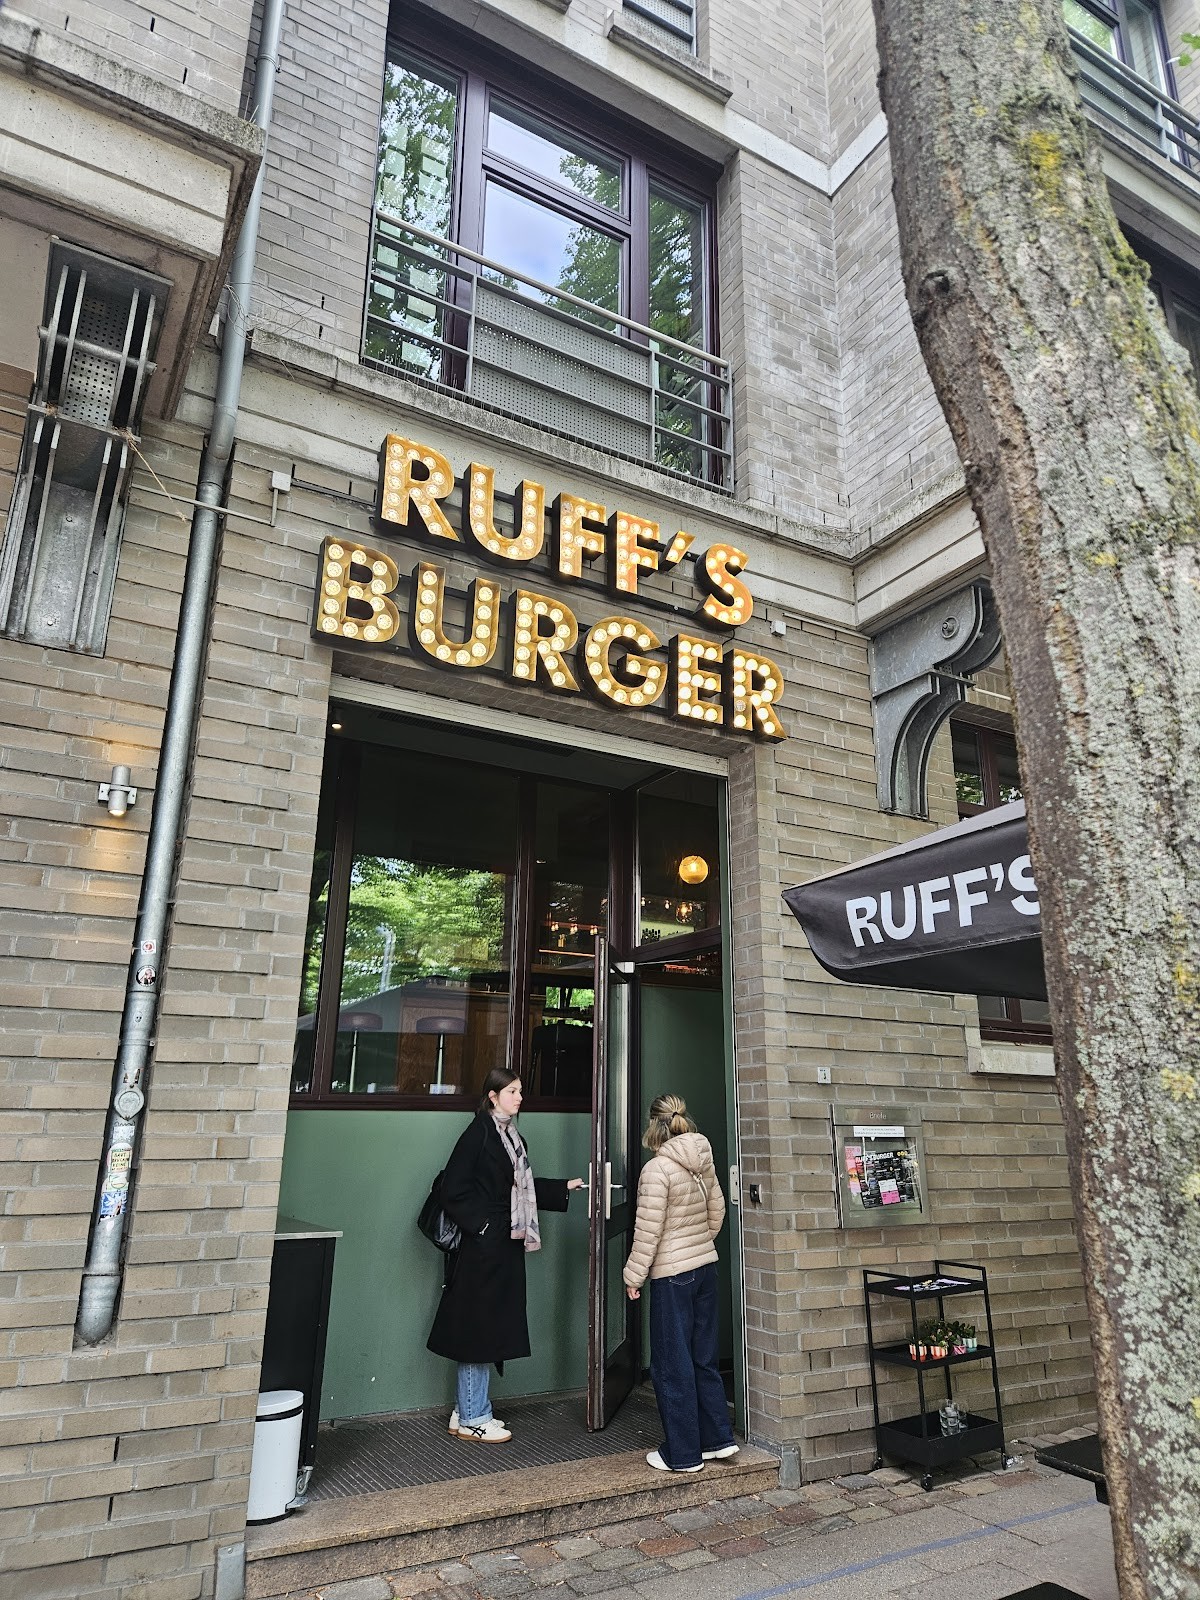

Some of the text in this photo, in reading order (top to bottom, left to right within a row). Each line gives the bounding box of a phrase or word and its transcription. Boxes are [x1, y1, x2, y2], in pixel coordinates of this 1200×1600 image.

[379, 433, 754, 628] RUFF'S
[314, 535, 787, 742] BURGER
[845, 854, 1041, 948] RUFF'S
